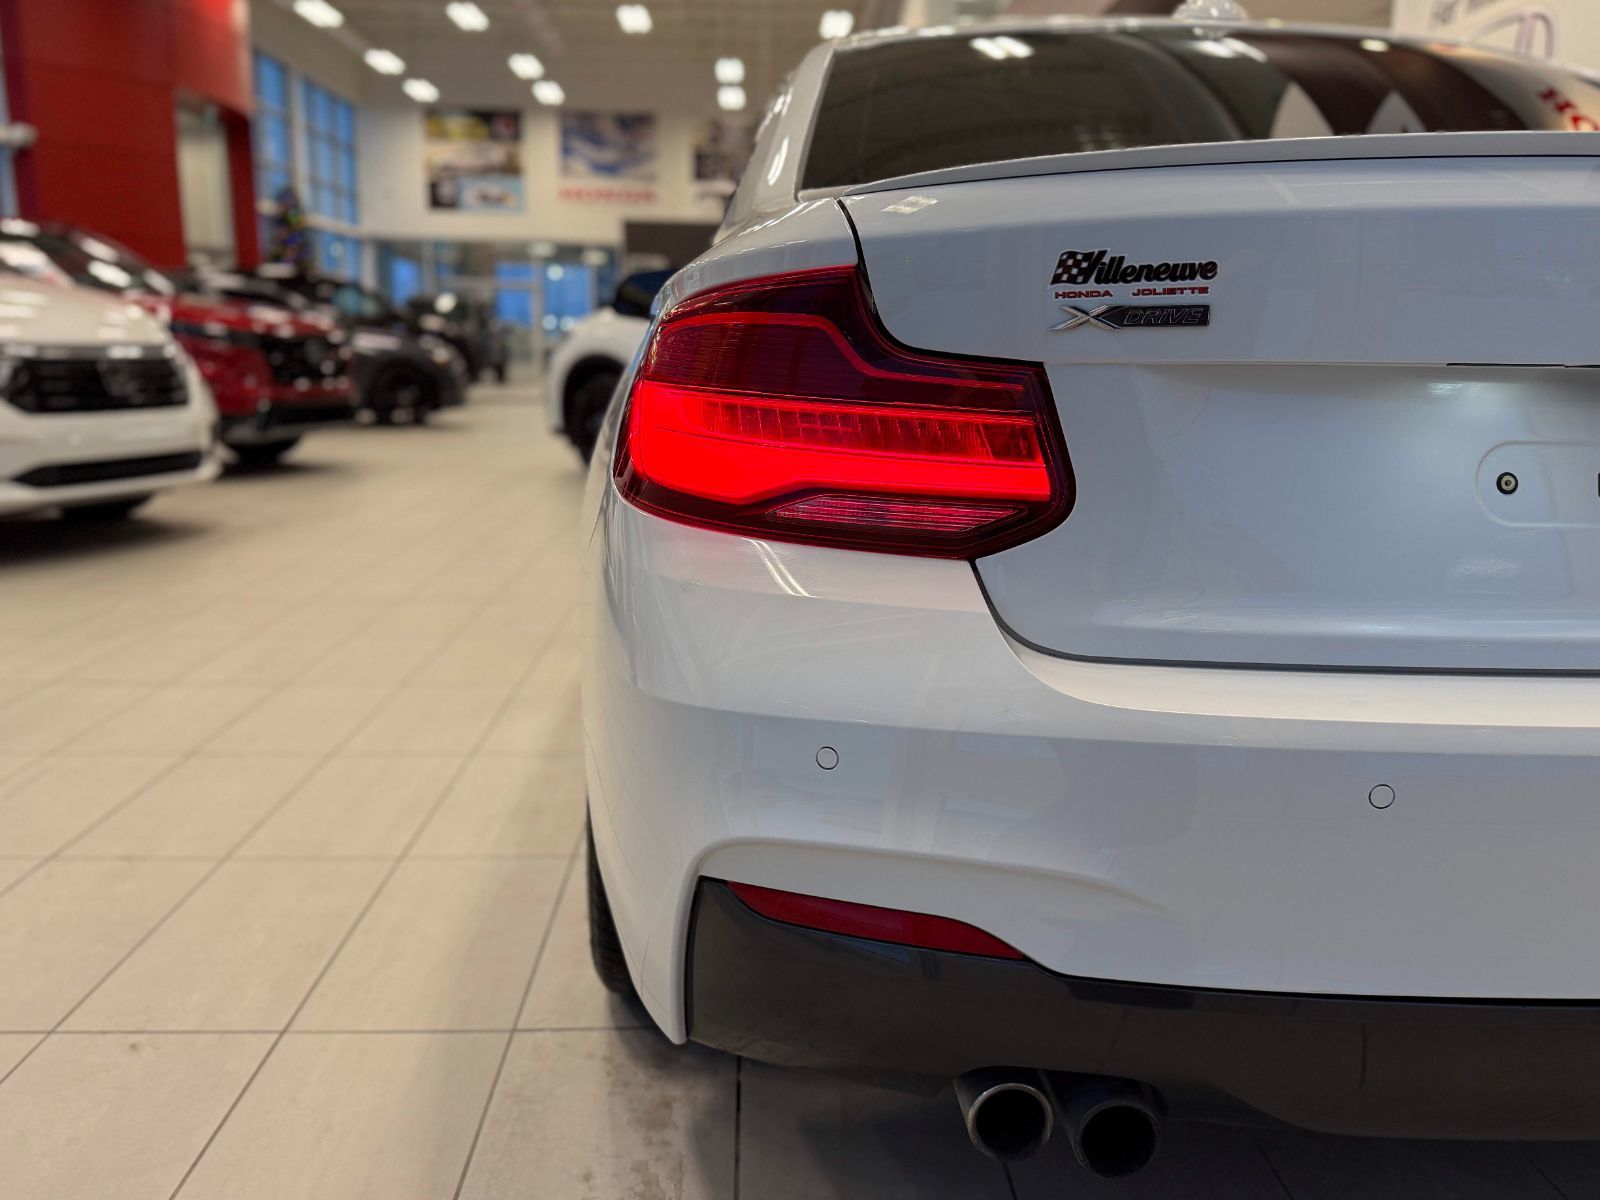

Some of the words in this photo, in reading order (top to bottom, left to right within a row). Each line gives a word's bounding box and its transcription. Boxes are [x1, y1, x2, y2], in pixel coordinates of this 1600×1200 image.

[1068, 249, 1218, 285] Villeneuve
[1053, 289, 1114, 299] HONDA
[1131, 286, 1210, 297] JOLIETTE
